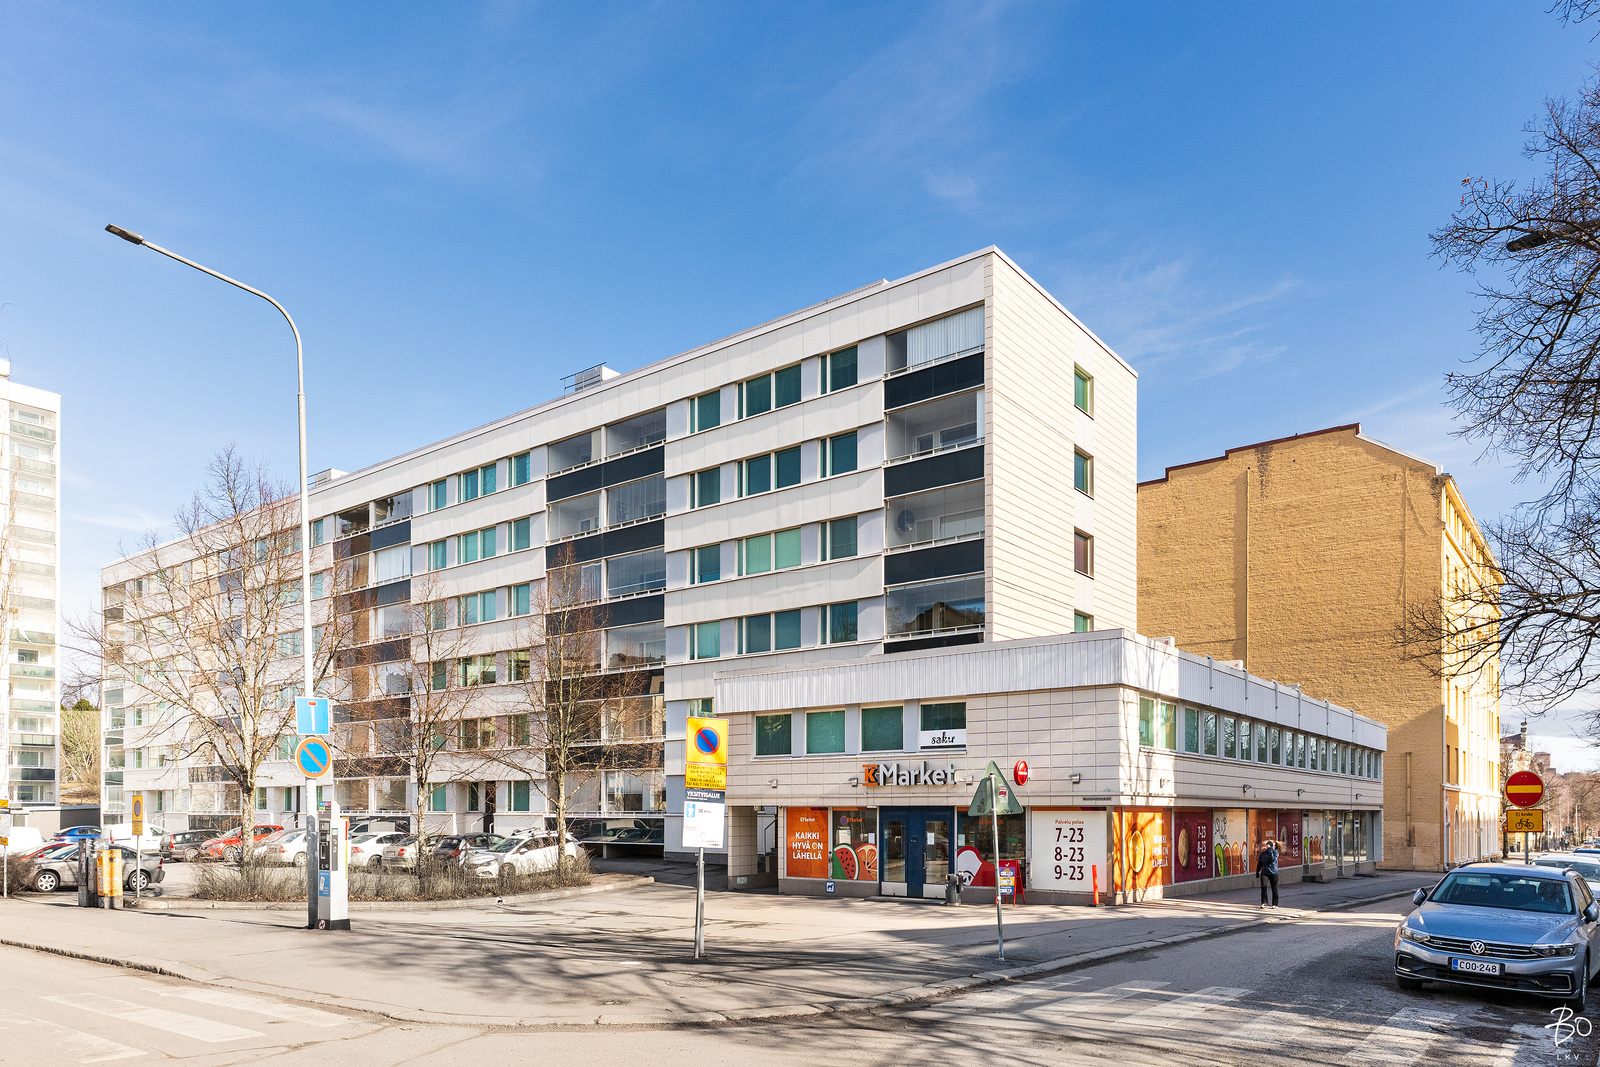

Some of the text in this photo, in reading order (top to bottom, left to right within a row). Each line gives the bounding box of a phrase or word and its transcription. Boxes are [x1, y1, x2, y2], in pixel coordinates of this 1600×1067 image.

[931, 732, 955, 744] saku
[879, 761, 956, 786] Market
[686, 791, 720, 799] YKSITYISALUE
[1055, 827, 1084, 842] 7-23
[792, 840, 810, 849] HYVÄ
[792, 850, 822, 859] LÄHELLÄ
[1054, 846, 1084, 862] 8-23
[1054, 864, 1084, 880] 9-23
